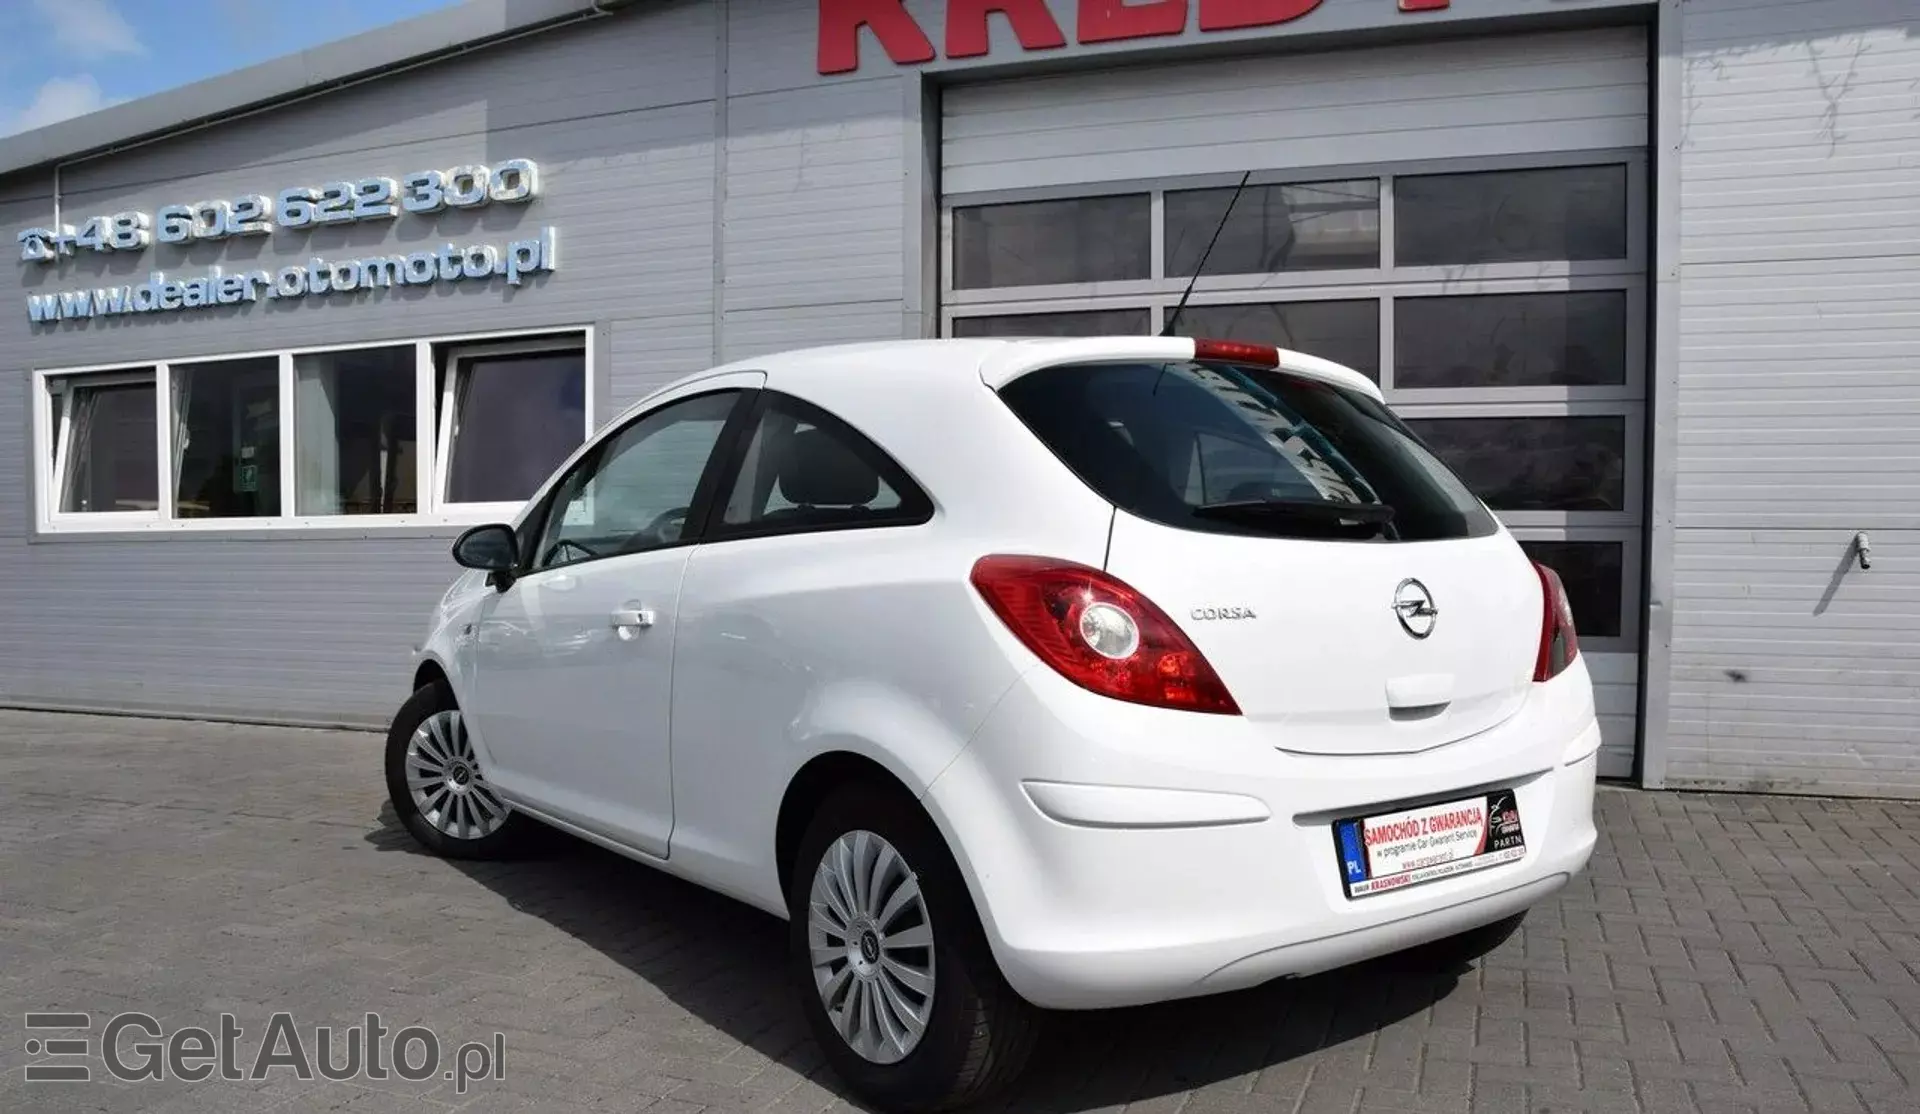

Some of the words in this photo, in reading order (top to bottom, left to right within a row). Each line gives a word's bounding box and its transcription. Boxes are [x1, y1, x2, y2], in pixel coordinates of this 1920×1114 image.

[55, 210, 150, 256] +48
[157, 194, 272, 245] 602
[276, 176, 399, 229] 622
[403, 158, 538, 214] 300
[26, 226, 557, 323] www.dealer.otomoto.pl
[1190, 606, 1257, 621] CORSA
[1363, 815, 1420, 847] SAMOCHÓD
[1420, 817, 1429, 835] Z
[1455, 828, 1477, 841] Service
[1346, 860, 1362, 875] PL
